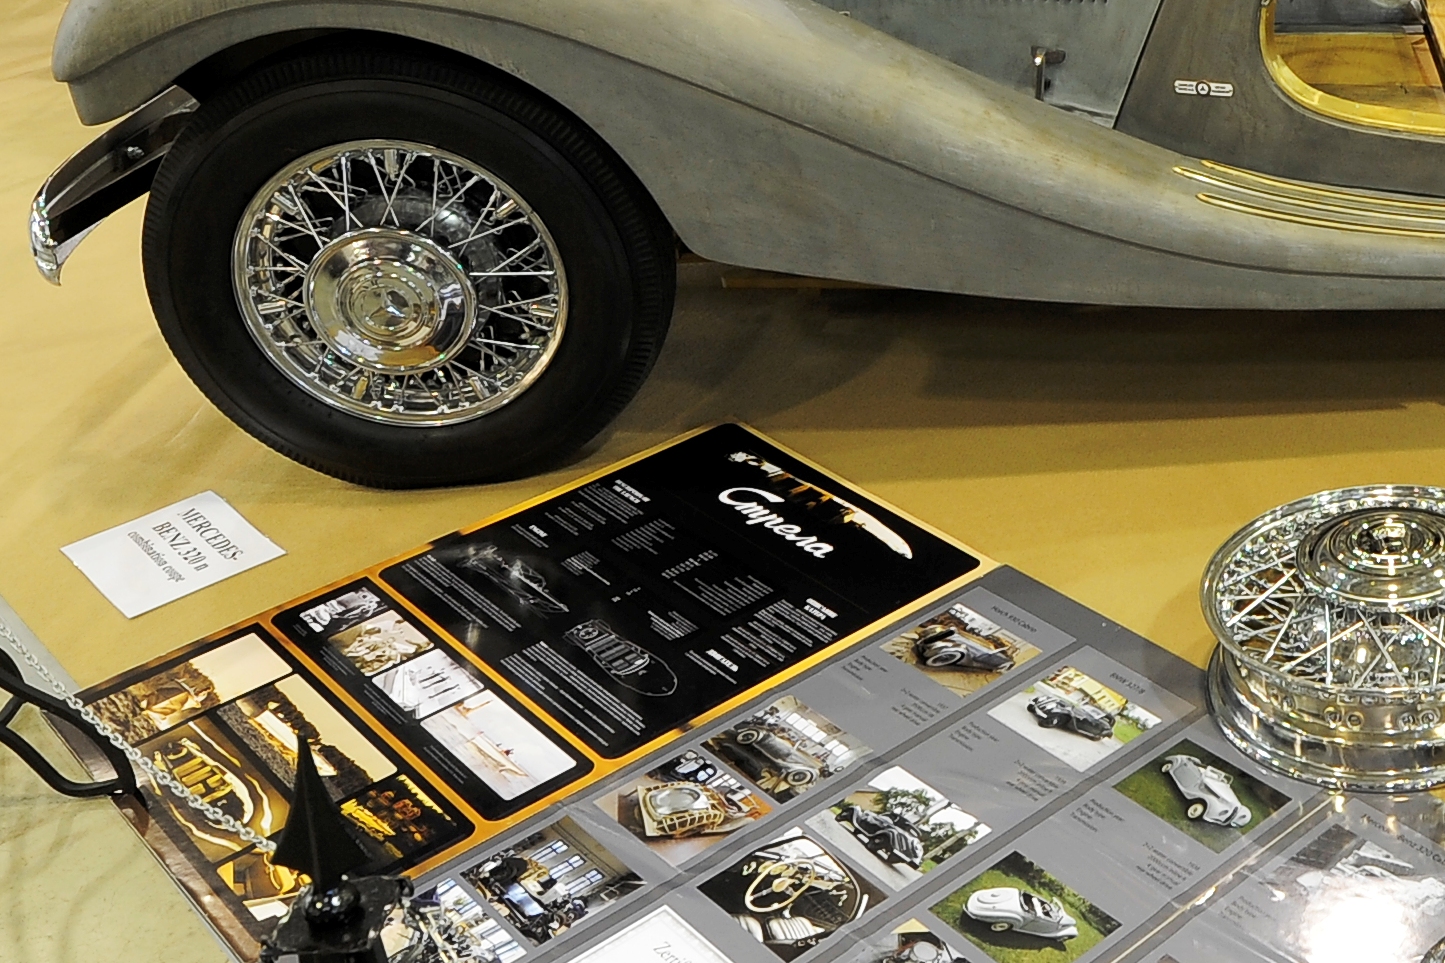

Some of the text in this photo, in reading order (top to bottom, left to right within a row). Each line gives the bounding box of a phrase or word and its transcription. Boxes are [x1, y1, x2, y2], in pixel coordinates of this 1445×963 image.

[152, 521, 191, 551] BENZ
[177, 547, 206, 566] 320
[718, 487, 834, 559] Стрела
